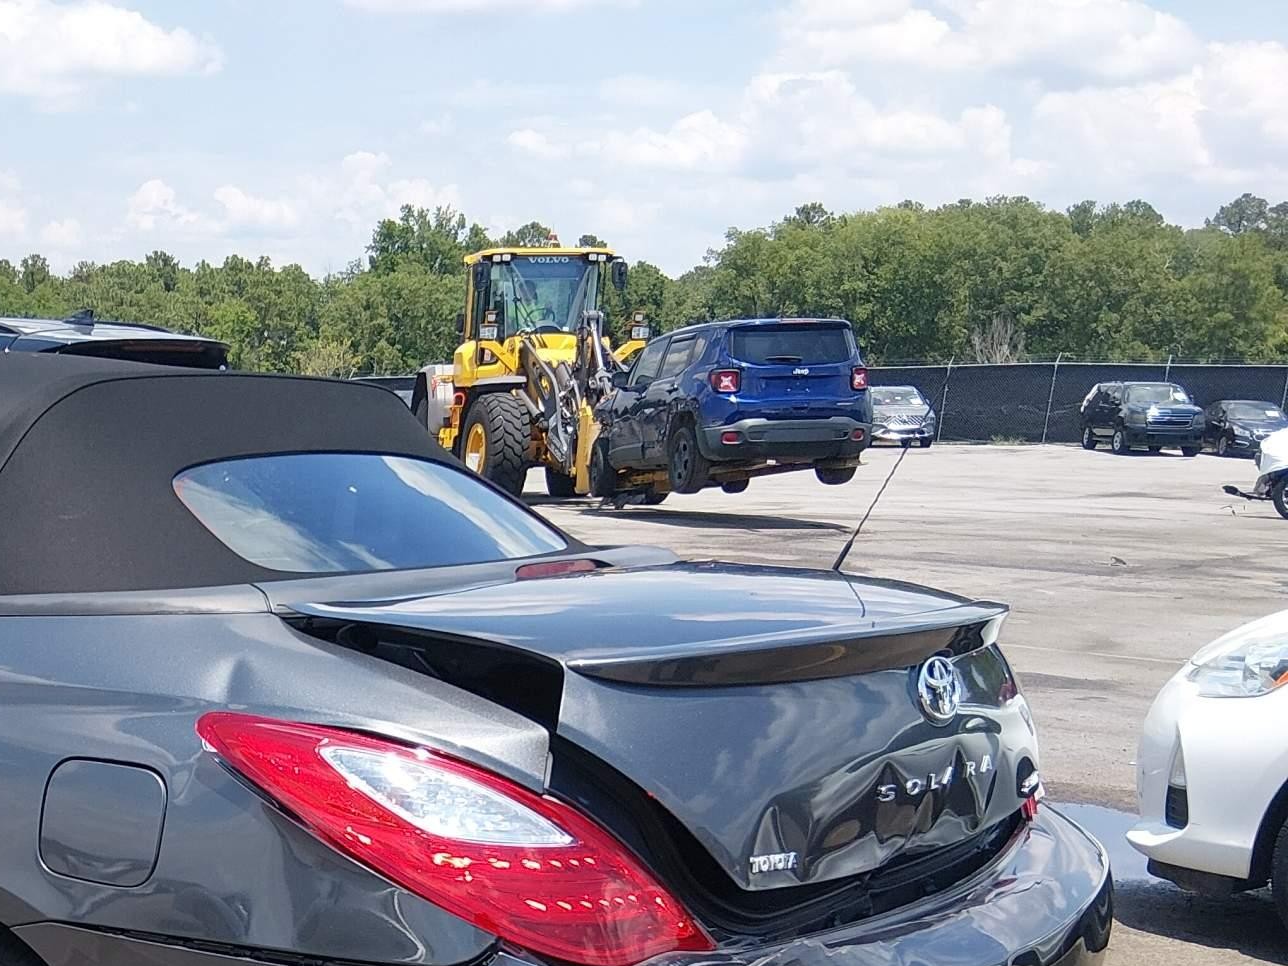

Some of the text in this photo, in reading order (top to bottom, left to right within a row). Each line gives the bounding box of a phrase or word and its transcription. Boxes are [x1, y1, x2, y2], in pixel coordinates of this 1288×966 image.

[527, 255, 570, 264] VOLVO
[792, 368, 810, 376] Jeep
[876, 754, 993, 803] SOLARA
[749, 851, 798, 873] TOYOTA
